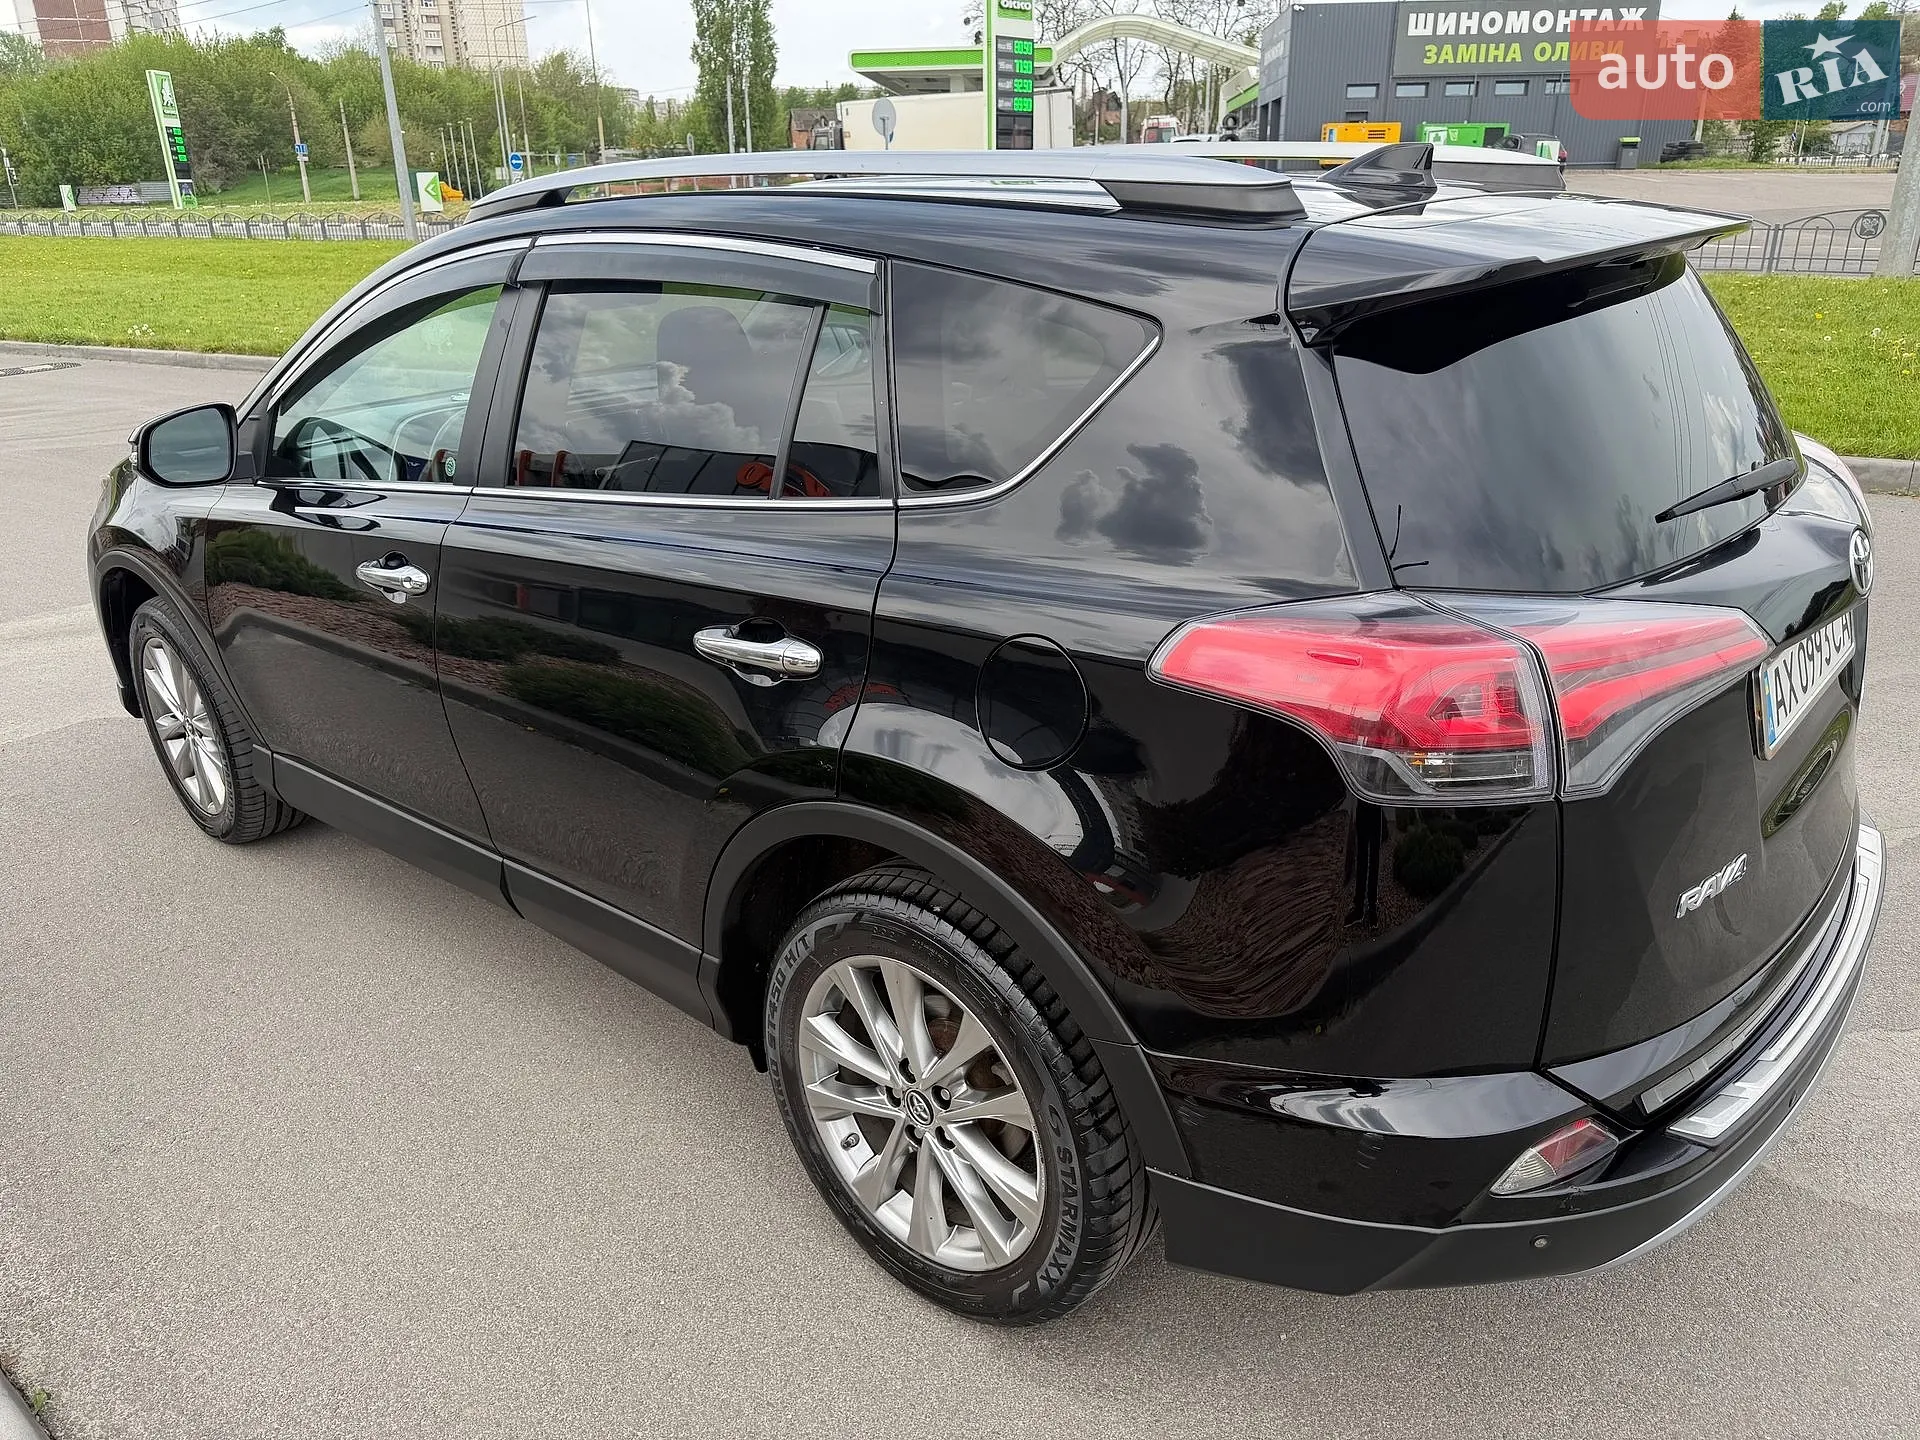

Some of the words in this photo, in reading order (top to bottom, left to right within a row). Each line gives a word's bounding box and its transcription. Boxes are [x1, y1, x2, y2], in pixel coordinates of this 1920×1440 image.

[1407, 7, 1647, 36] ШИНОМОНТАЖ
[1423, 42, 1522, 64] ЗАМІНА
[1533, 40, 1624, 62] ОЛИВИ
[1675, 852, 1747, 919] RAV4
[1040, 1145, 1078, 1290] STARMAXX
